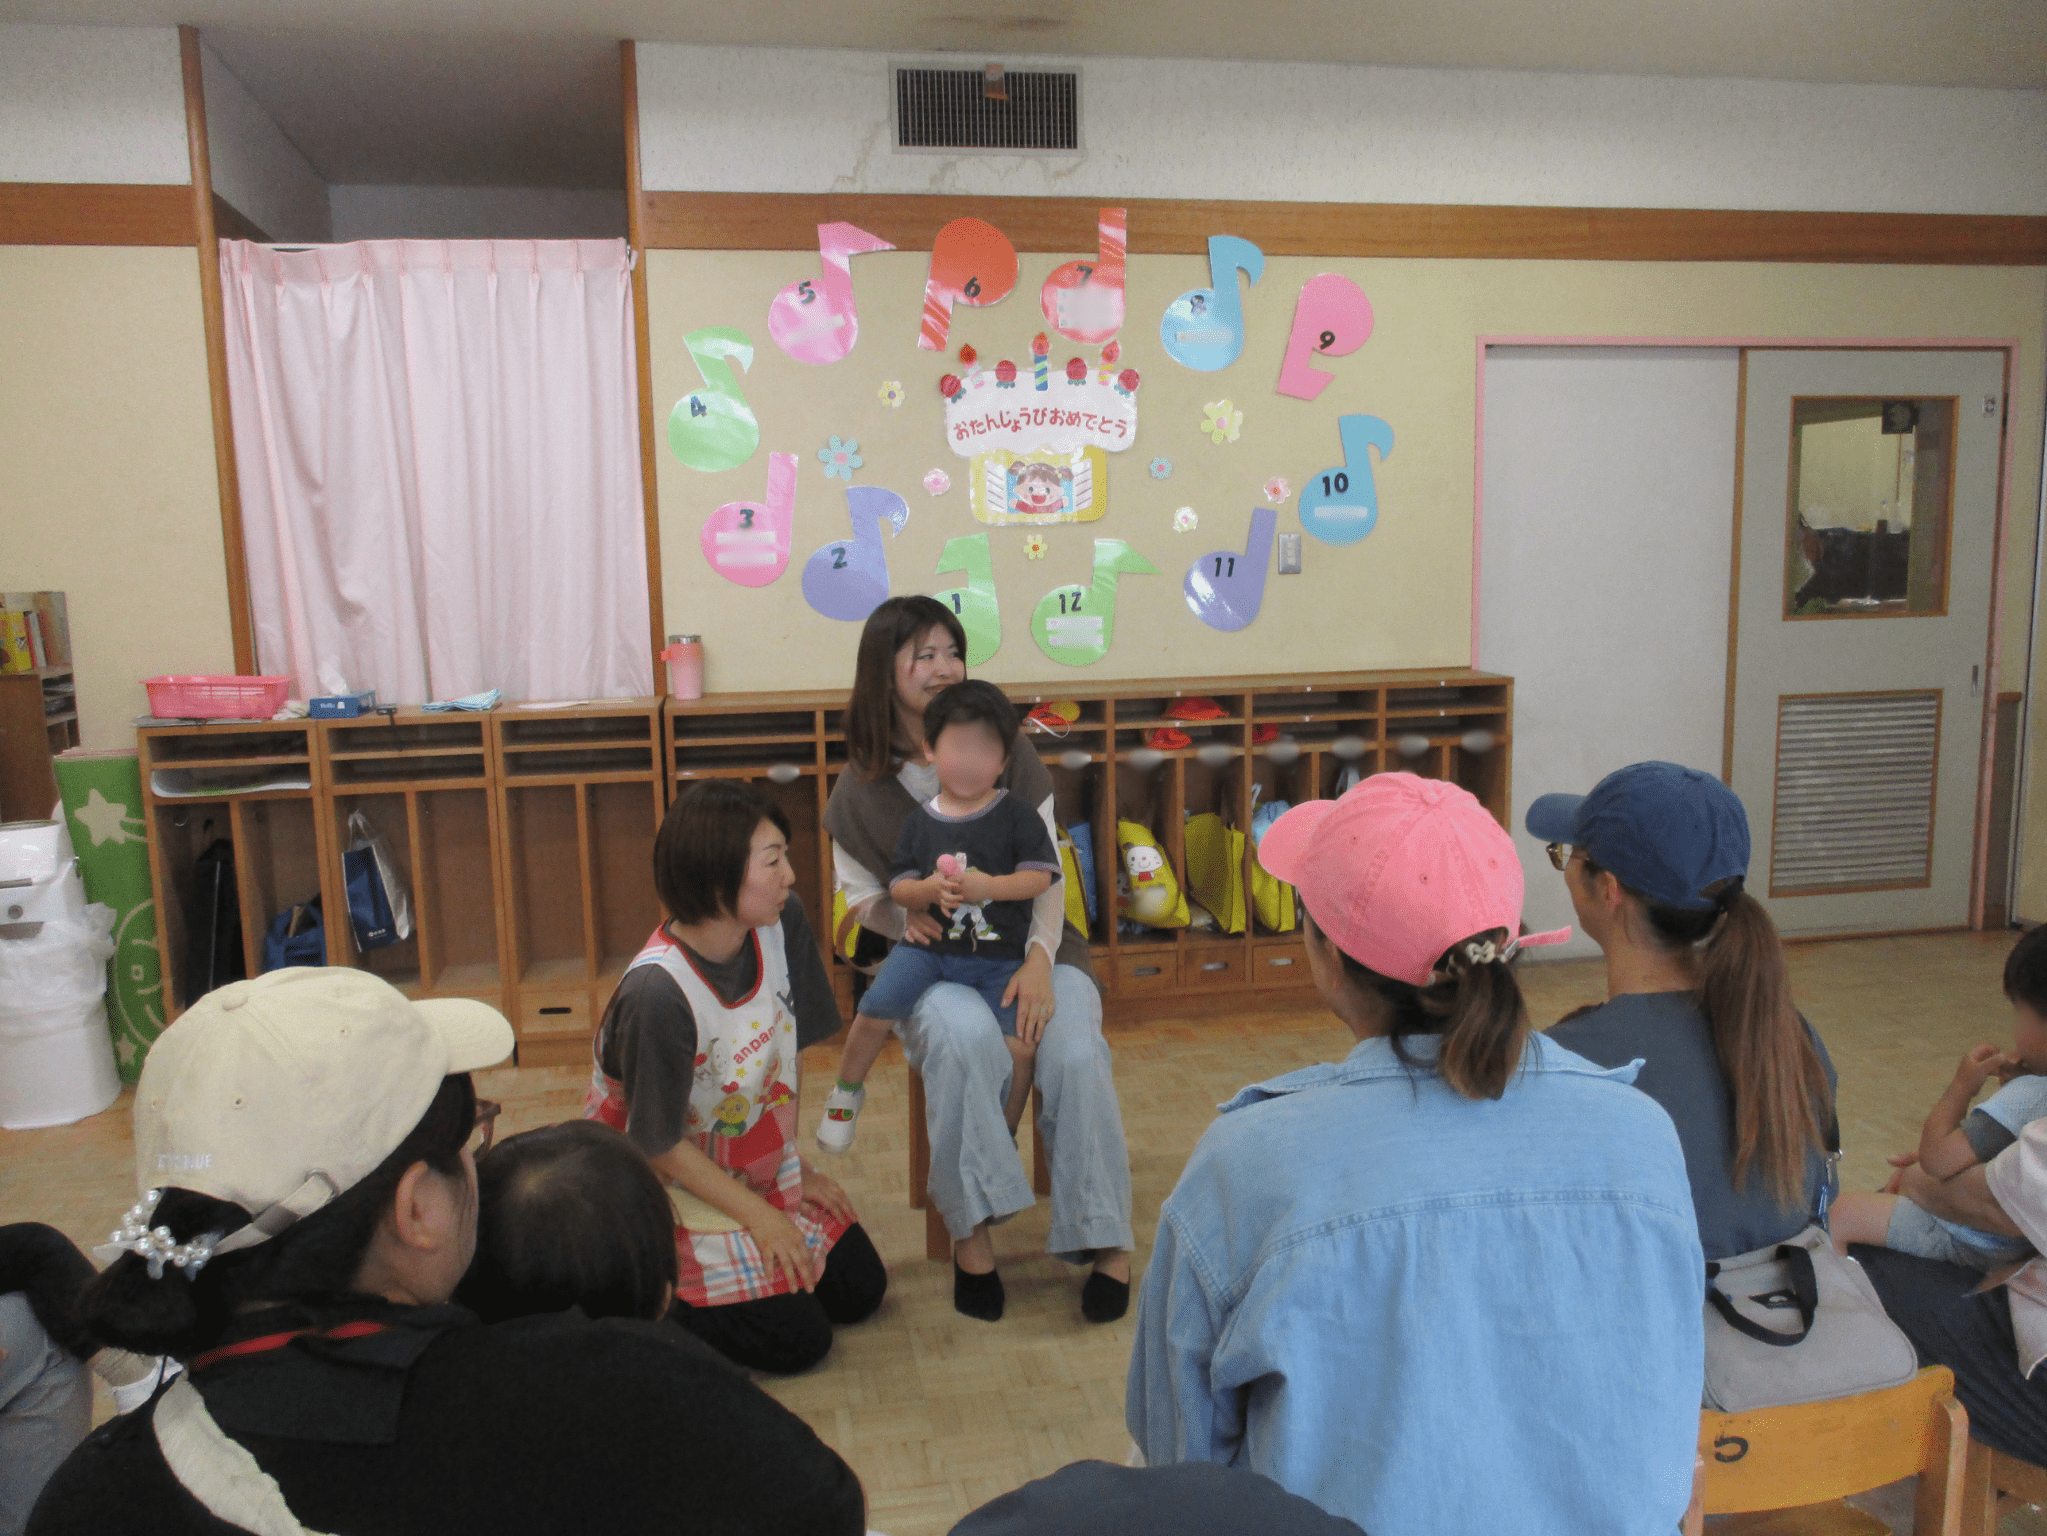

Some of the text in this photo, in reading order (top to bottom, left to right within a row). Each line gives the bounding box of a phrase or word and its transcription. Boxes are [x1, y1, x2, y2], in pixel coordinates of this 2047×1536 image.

[1076, 264, 1093, 286] 7
[797, 280, 815, 304] 5
[964, 277, 981, 298] 6
[1319, 330, 1336, 350] 9
[690, 396, 707, 417] 4
[953, 407, 1127, 440] おたんじょうびおめでとう
[1322, 473, 1349, 497] 10
[739, 508, 754, 529] 3
[831, 547, 848, 570] 2
[1215, 557, 1235, 578] 11
[951, 593, 962, 615] 1
[1058, 591, 1082, 614] 12
